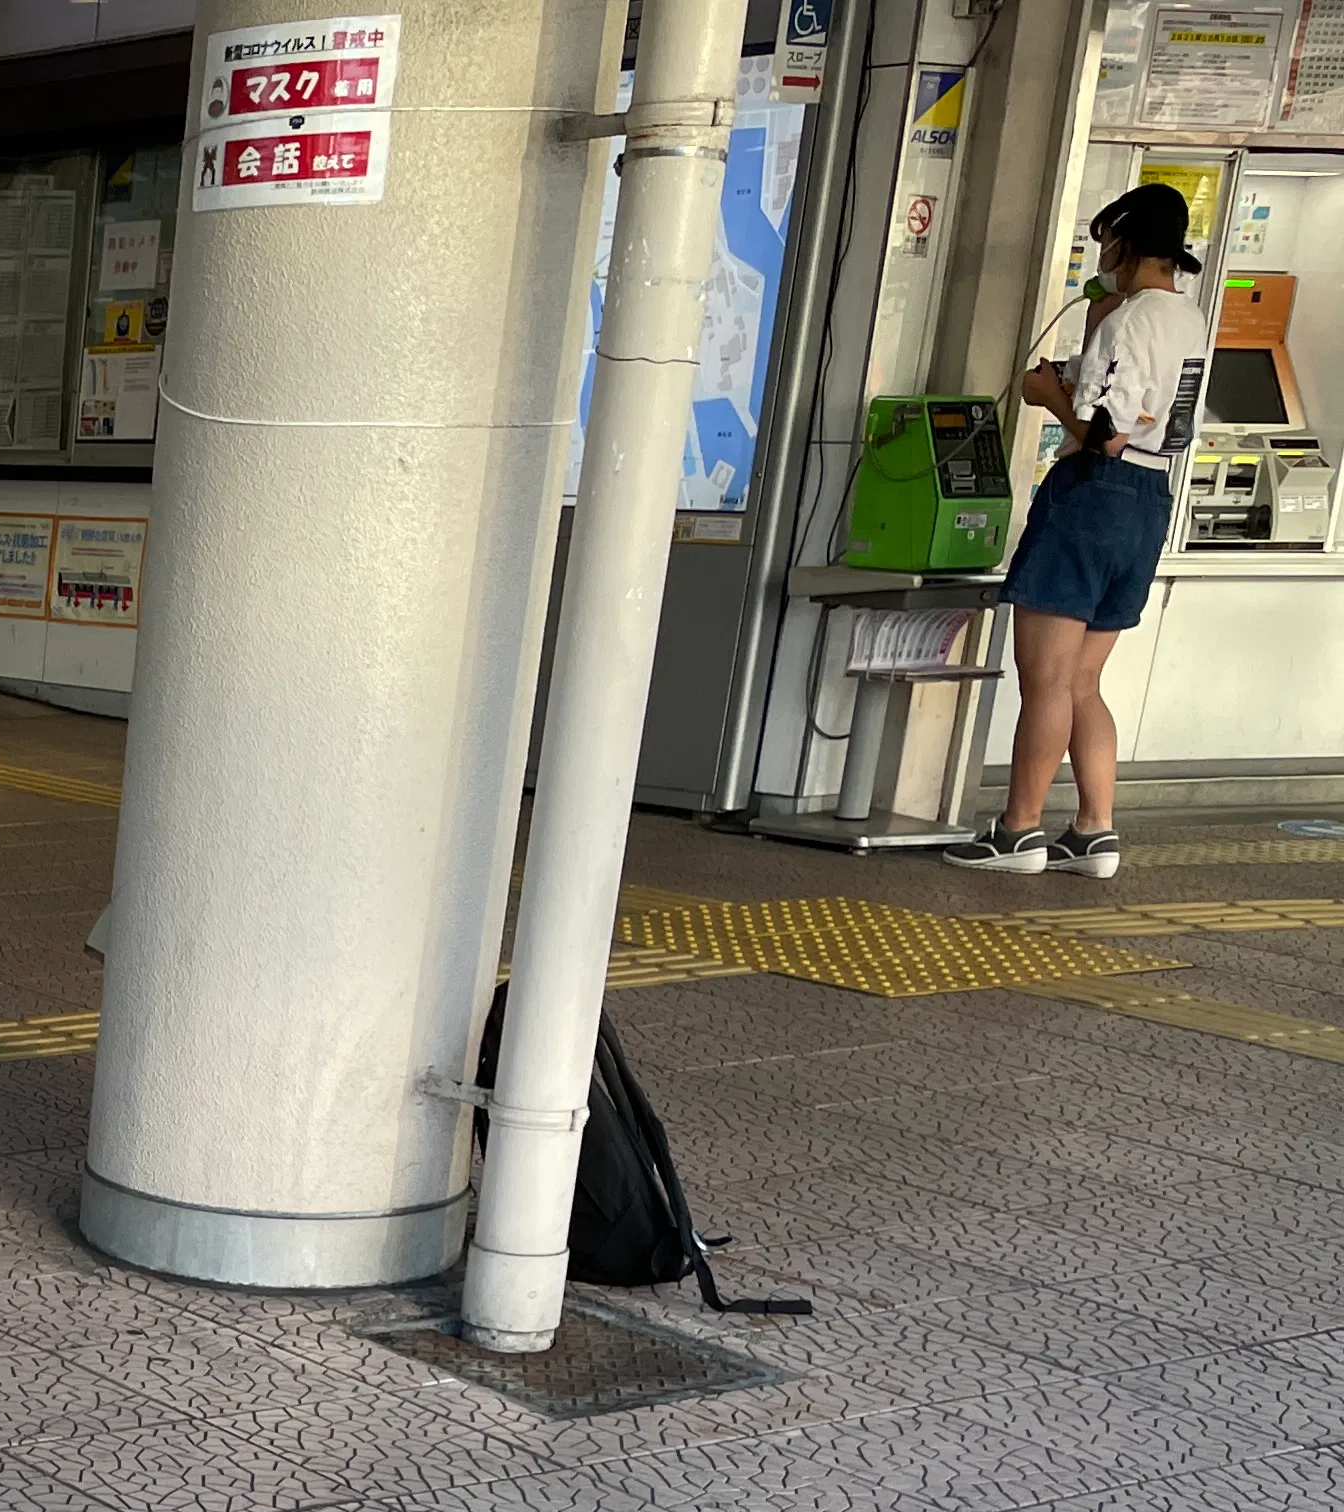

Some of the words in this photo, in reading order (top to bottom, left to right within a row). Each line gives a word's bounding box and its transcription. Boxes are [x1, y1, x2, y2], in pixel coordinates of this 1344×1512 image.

[246, 70, 320, 104] マスク
[237, 142, 301, 178] 会話
[312, 154, 355, 172] 控えて
